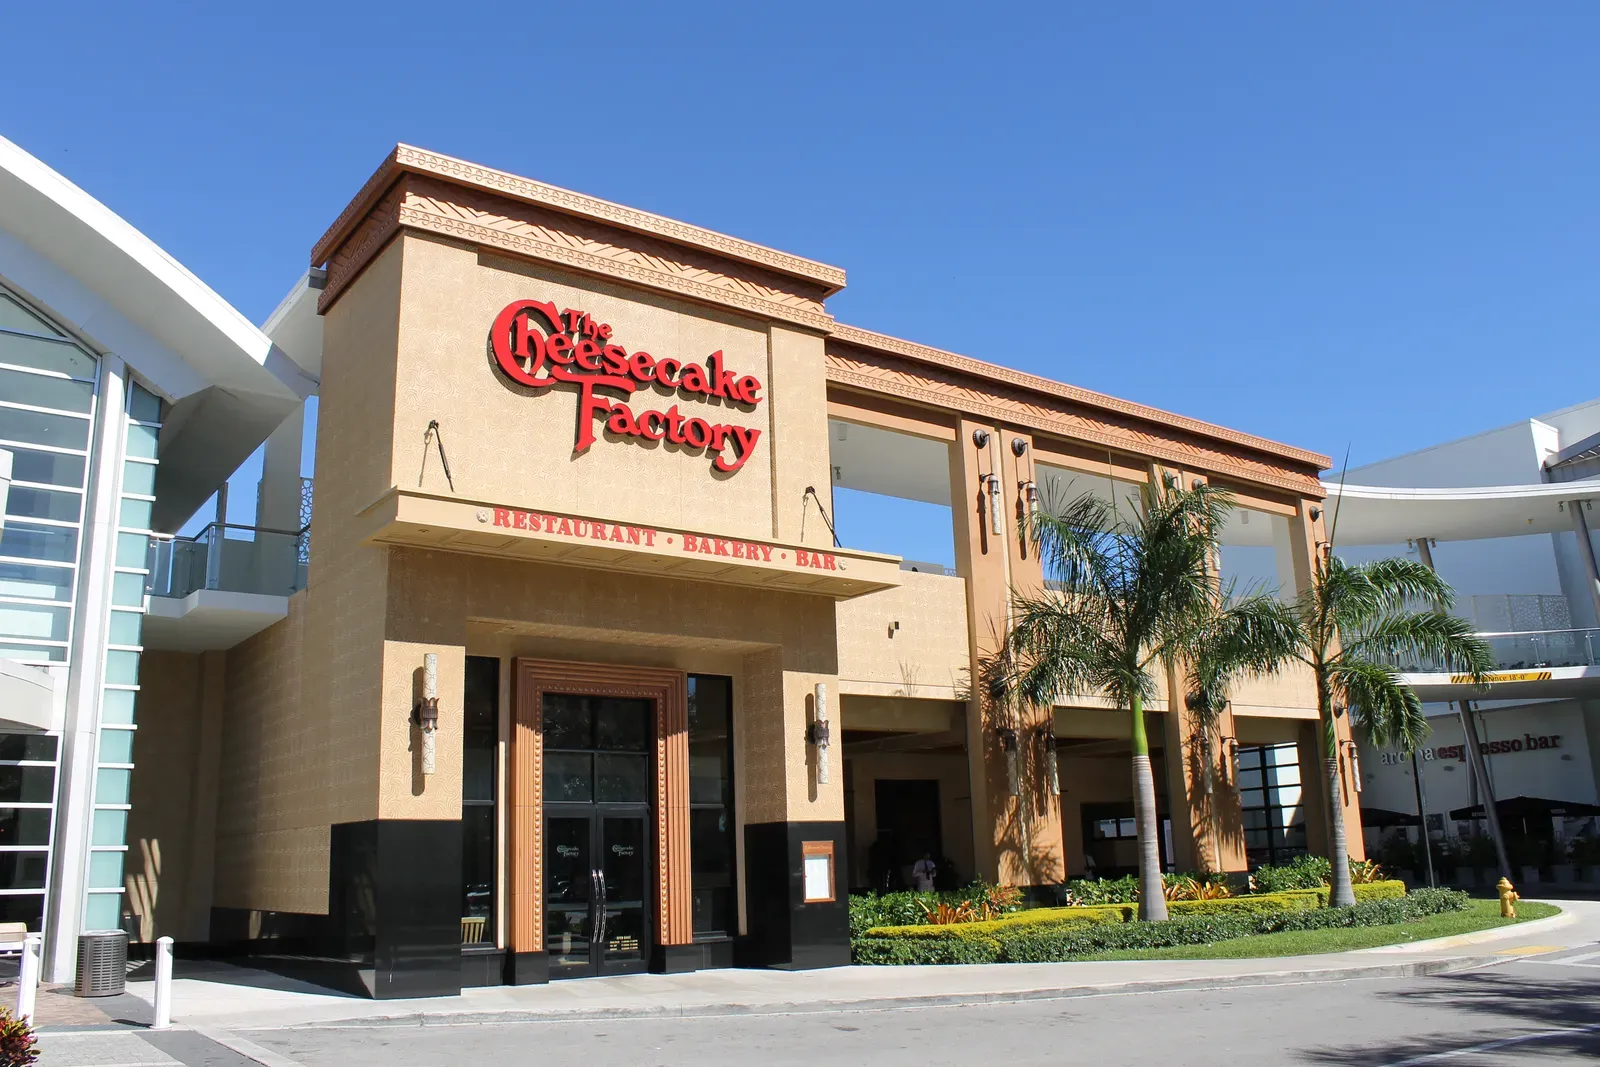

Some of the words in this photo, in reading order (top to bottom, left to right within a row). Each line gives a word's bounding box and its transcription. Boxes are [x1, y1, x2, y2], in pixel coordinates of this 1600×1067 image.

[490, 298, 764, 404] Cheesecake
[562, 307, 613, 340] The
[551, 364, 762, 472] Factory
[492, 506, 657, 548] RESTAURANT
[682, 533, 774, 563] BAKERY
[794, 549, 837, 572] BAR
[1524, 733, 1561, 751] bar
